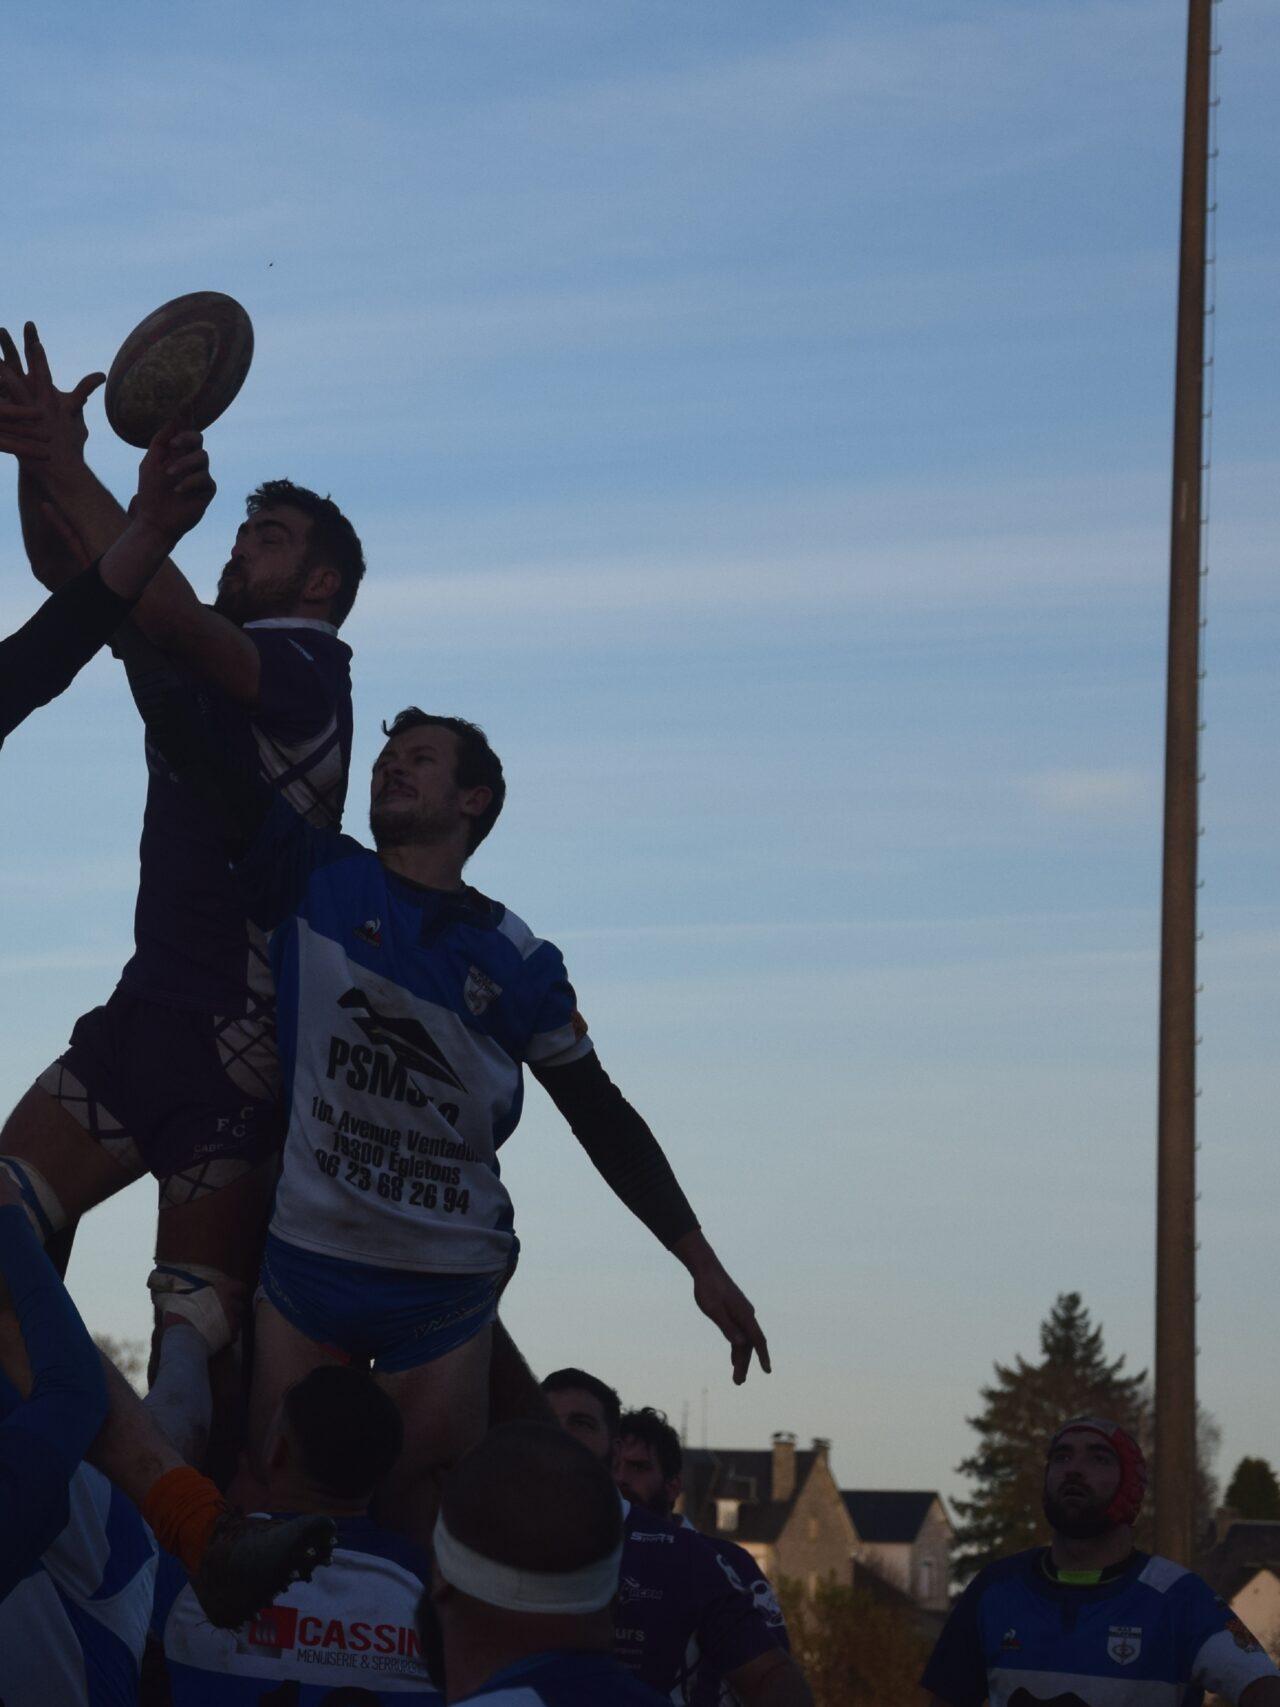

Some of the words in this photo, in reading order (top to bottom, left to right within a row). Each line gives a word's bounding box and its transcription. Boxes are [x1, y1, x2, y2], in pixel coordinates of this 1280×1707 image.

[338, 1110, 401, 1148] Avenue
[333, 1131, 384, 1168] 19300
[389, 1147, 461, 1185] Égletons
[315, 1149, 340, 1178] 06
[345, 1161, 371, 1191] 23
[377, 1172, 404, 1201] 68
[409, 1182, 437, 1209] 26
[443, 1187, 470, 1214] 94
[296, 1648, 358, 1668] MENUISERIE
[359, 1655, 371, 1670] &
